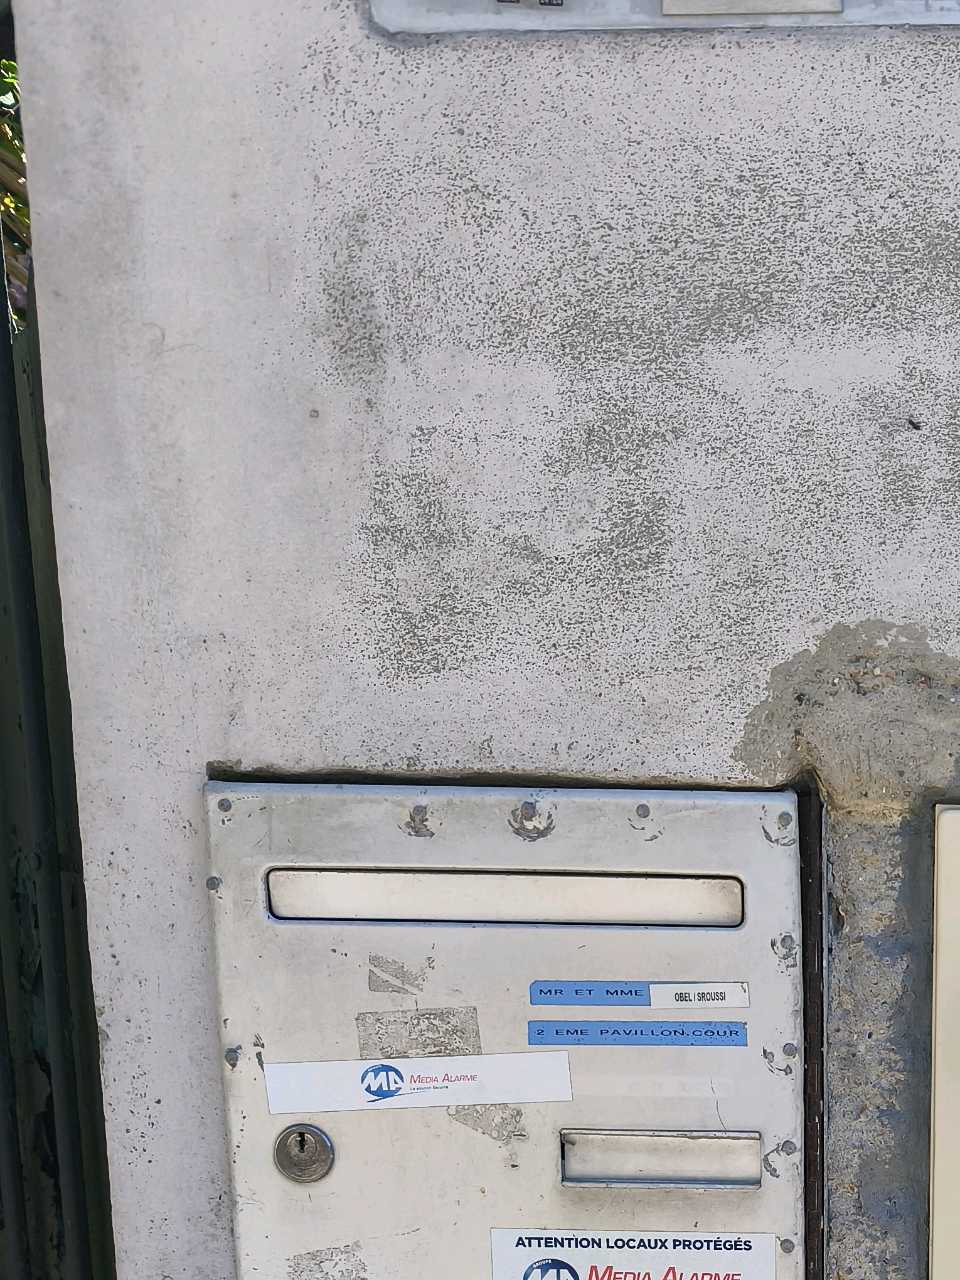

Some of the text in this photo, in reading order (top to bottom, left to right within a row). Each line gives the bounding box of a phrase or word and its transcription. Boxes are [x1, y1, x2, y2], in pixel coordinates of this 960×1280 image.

[538, 988, 644, 998] MR ET MME
[674, 992, 692, 1002] OBEL
[696, 991, 726, 1002] SROUSSI
[535, 1028, 545, 1036] 2
[555, 1028, 591, 1037] EME
[515, 1236, 753, 1251] ATTENTION LOCAUX PROTÉGÉS
